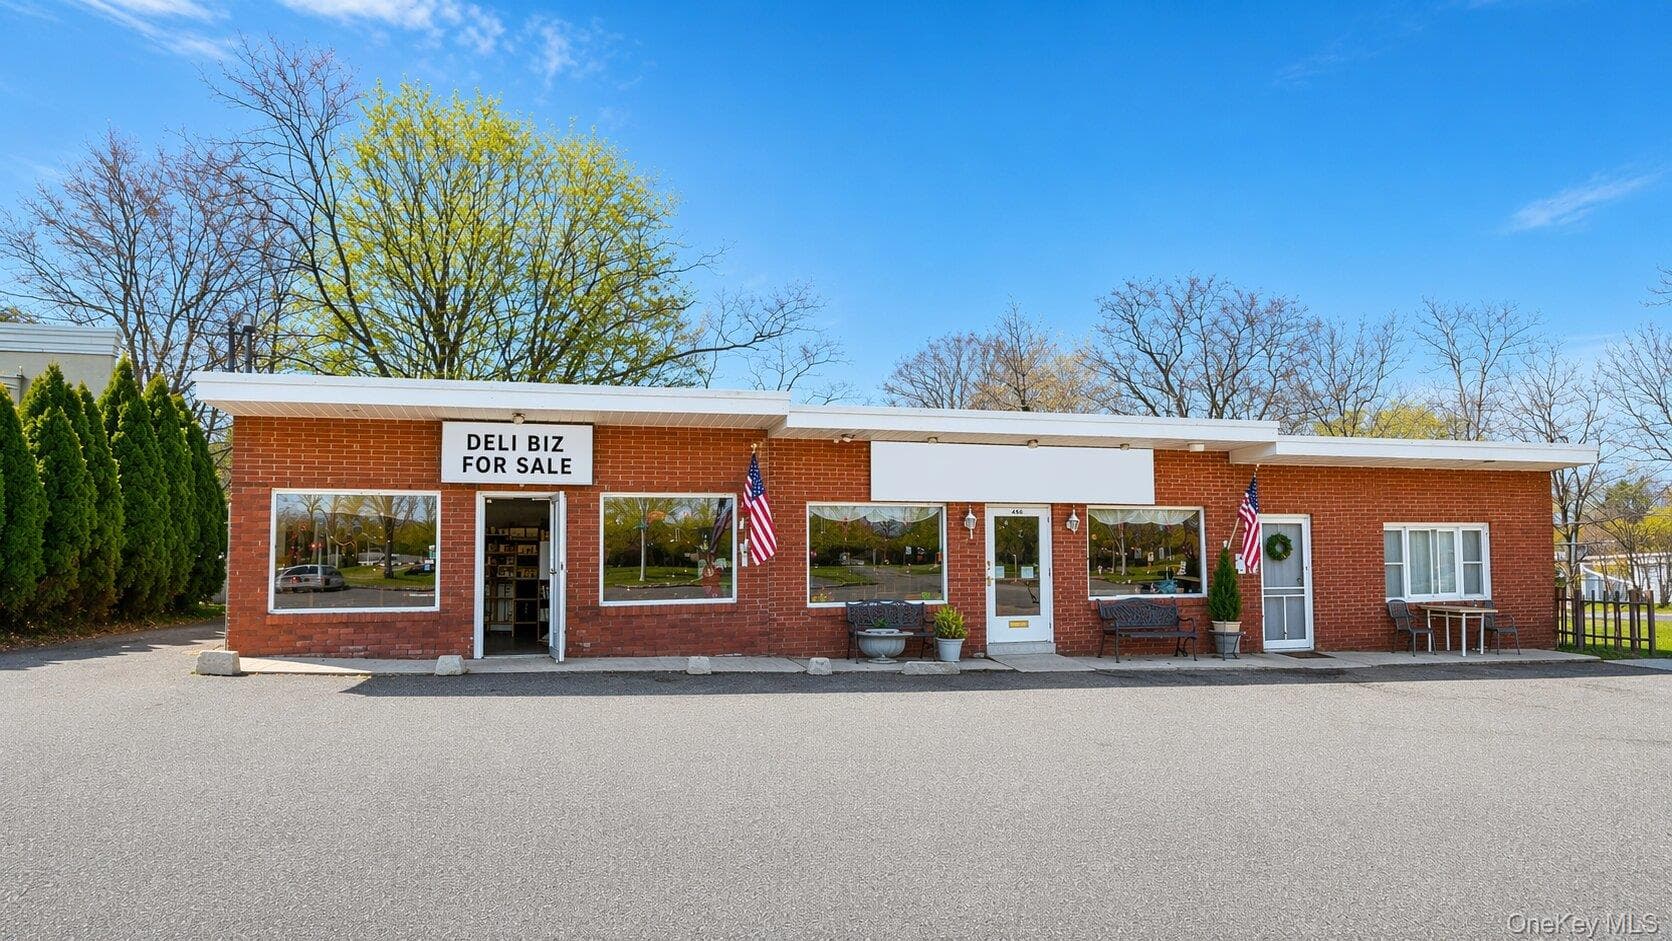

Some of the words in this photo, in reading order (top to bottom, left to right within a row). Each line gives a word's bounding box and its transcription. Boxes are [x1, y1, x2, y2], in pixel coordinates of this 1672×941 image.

[466, 433, 516, 451] DELI
[527, 435, 564, 452] BIZ
[462, 456, 507, 473] FOR
[516, 457, 572, 474] SALE
